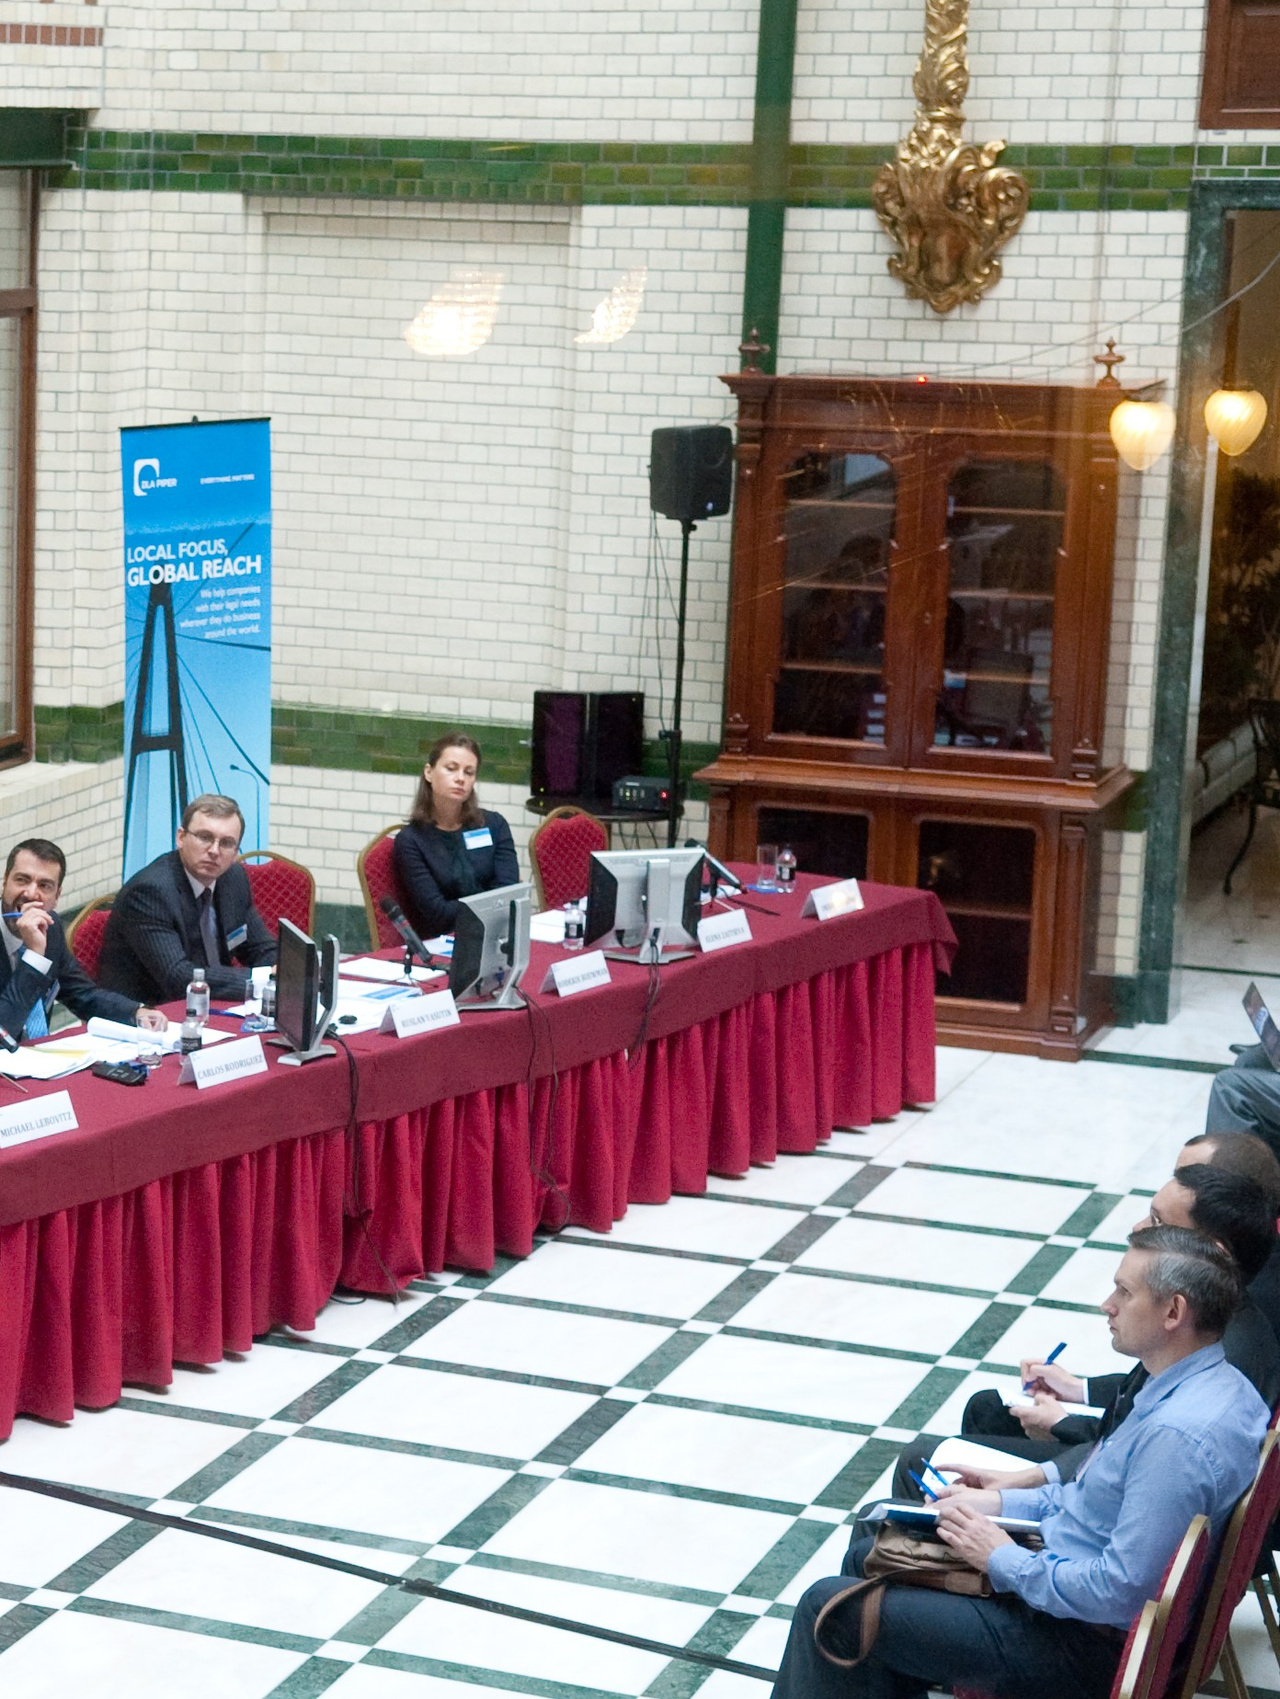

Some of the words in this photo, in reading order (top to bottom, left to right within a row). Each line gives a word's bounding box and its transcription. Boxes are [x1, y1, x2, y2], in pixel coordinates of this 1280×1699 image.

[127, 544, 176, 563] LOCAL
[178, 538, 229, 559] FOCUS,
[127, 561, 199, 587] GLOBAL
[201, 554, 262, 579] REACH
[197, 1065, 225, 1080] CARLOS
[225, 1055, 263, 1073] RODRIGUEZ
[0, 1121, 35, 1138] MICHAEL
[35, 1111, 73, 1129] LEBOVITZ
